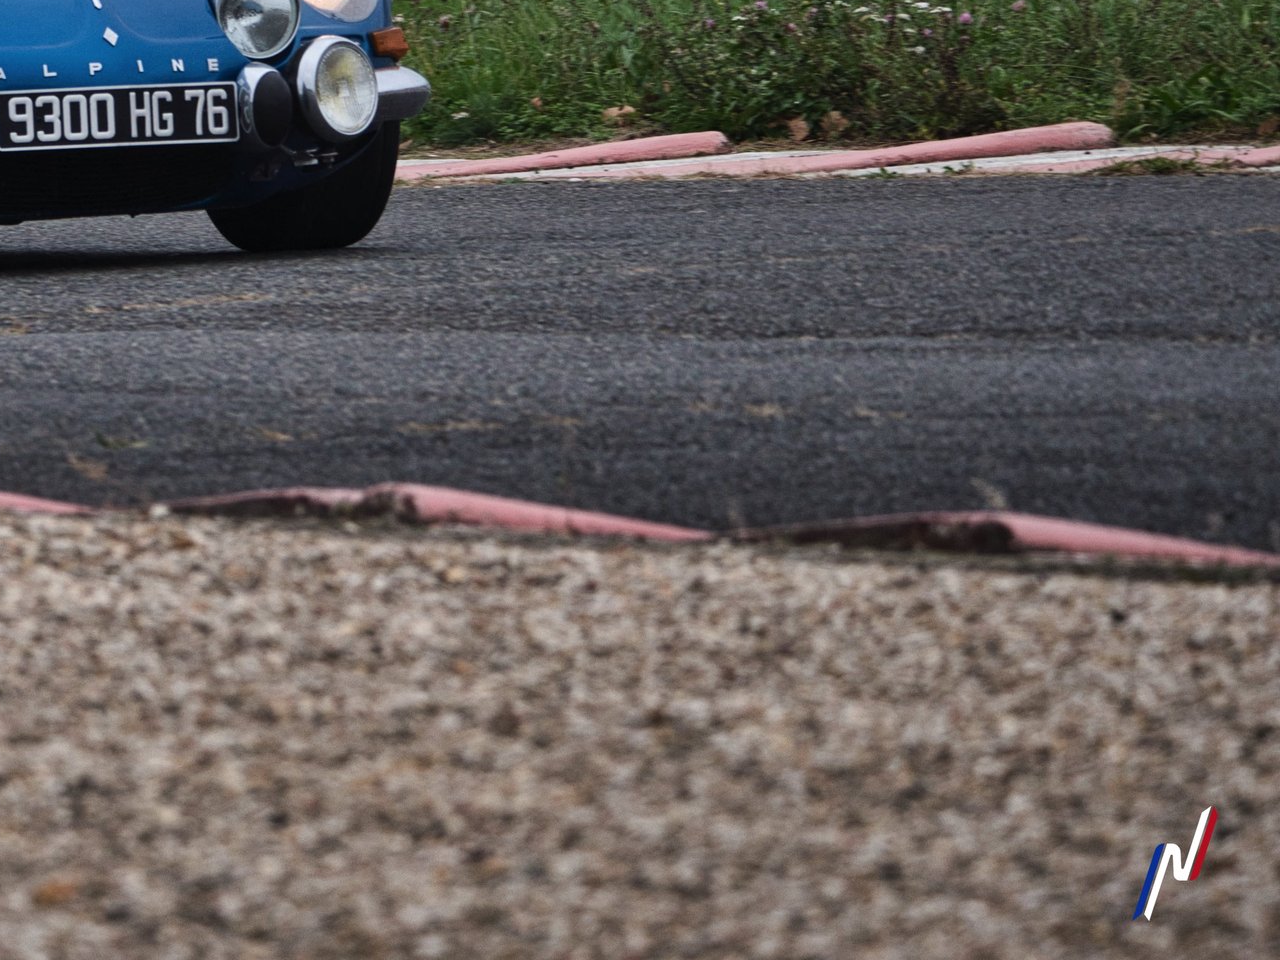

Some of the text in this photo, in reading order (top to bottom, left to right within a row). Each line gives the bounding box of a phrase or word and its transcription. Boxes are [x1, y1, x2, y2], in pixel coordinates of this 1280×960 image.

[8, 89, 229, 143] 9300 HG 76
